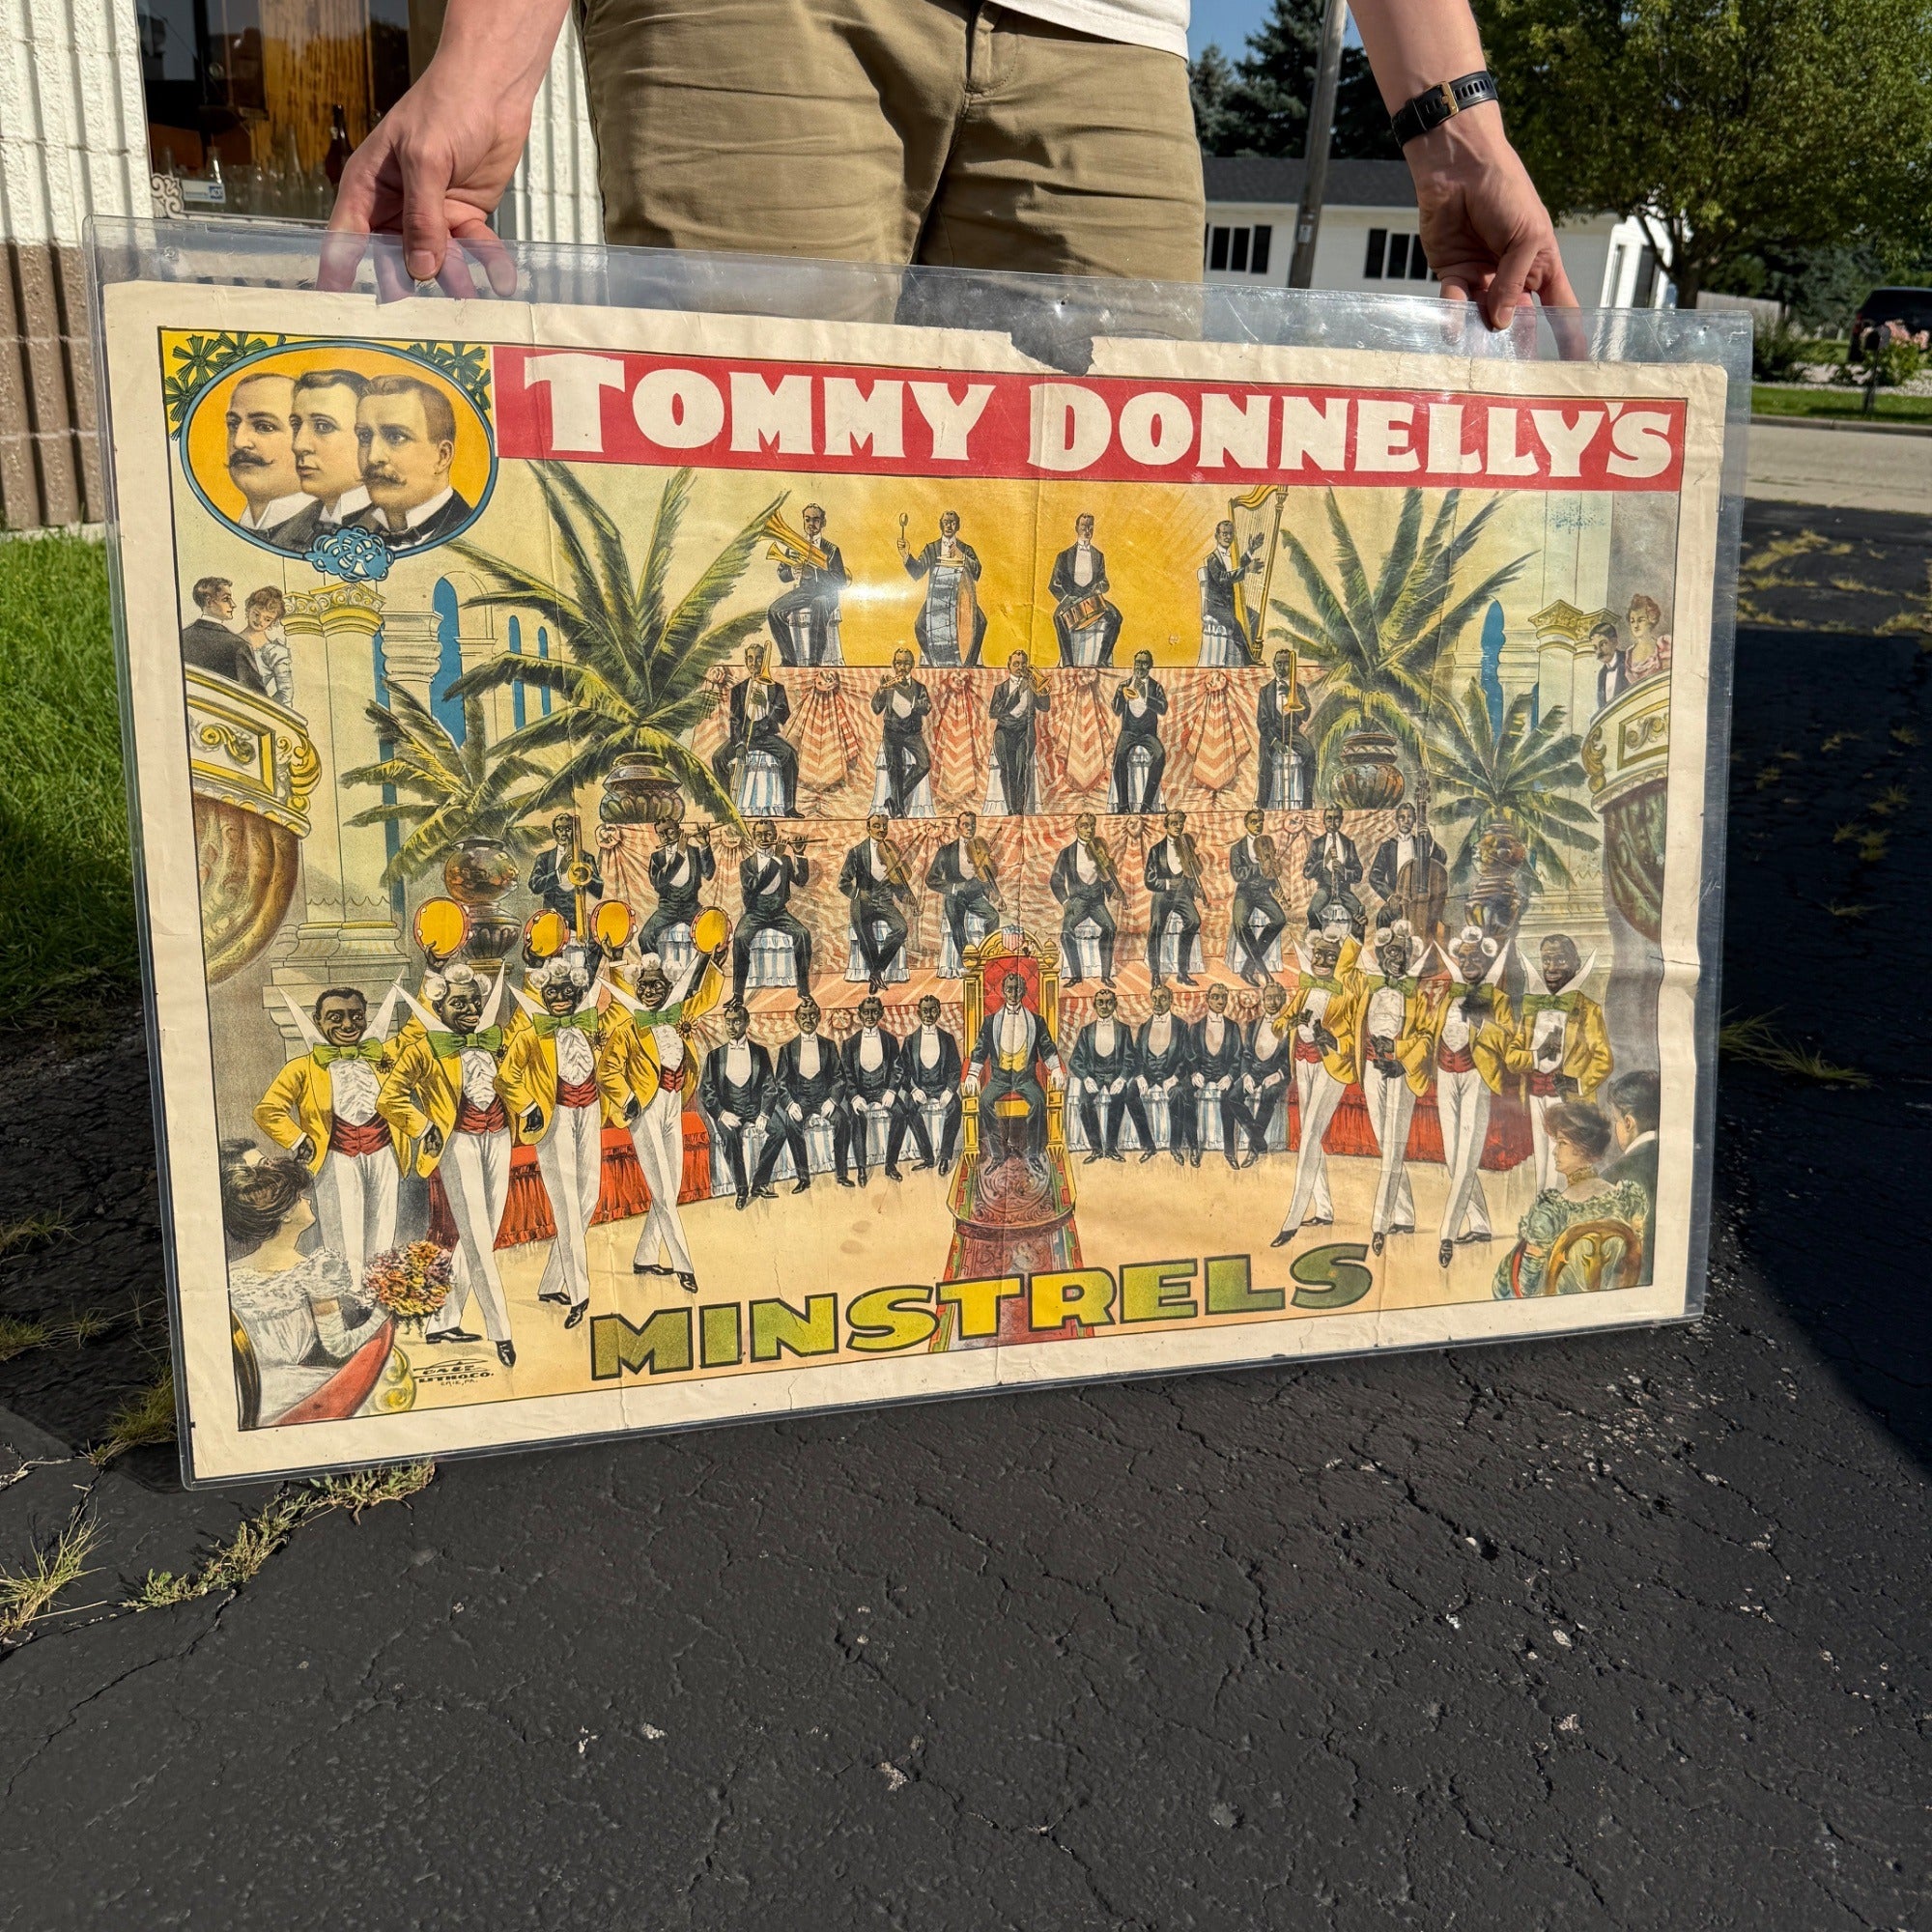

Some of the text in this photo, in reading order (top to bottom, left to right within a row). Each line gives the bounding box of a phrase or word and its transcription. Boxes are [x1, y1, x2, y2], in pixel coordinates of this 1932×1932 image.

[524, 354, 1674, 481] TOMMY DONNELLY'S
[591, 1243, 1373, 1381] MINSTRELS
